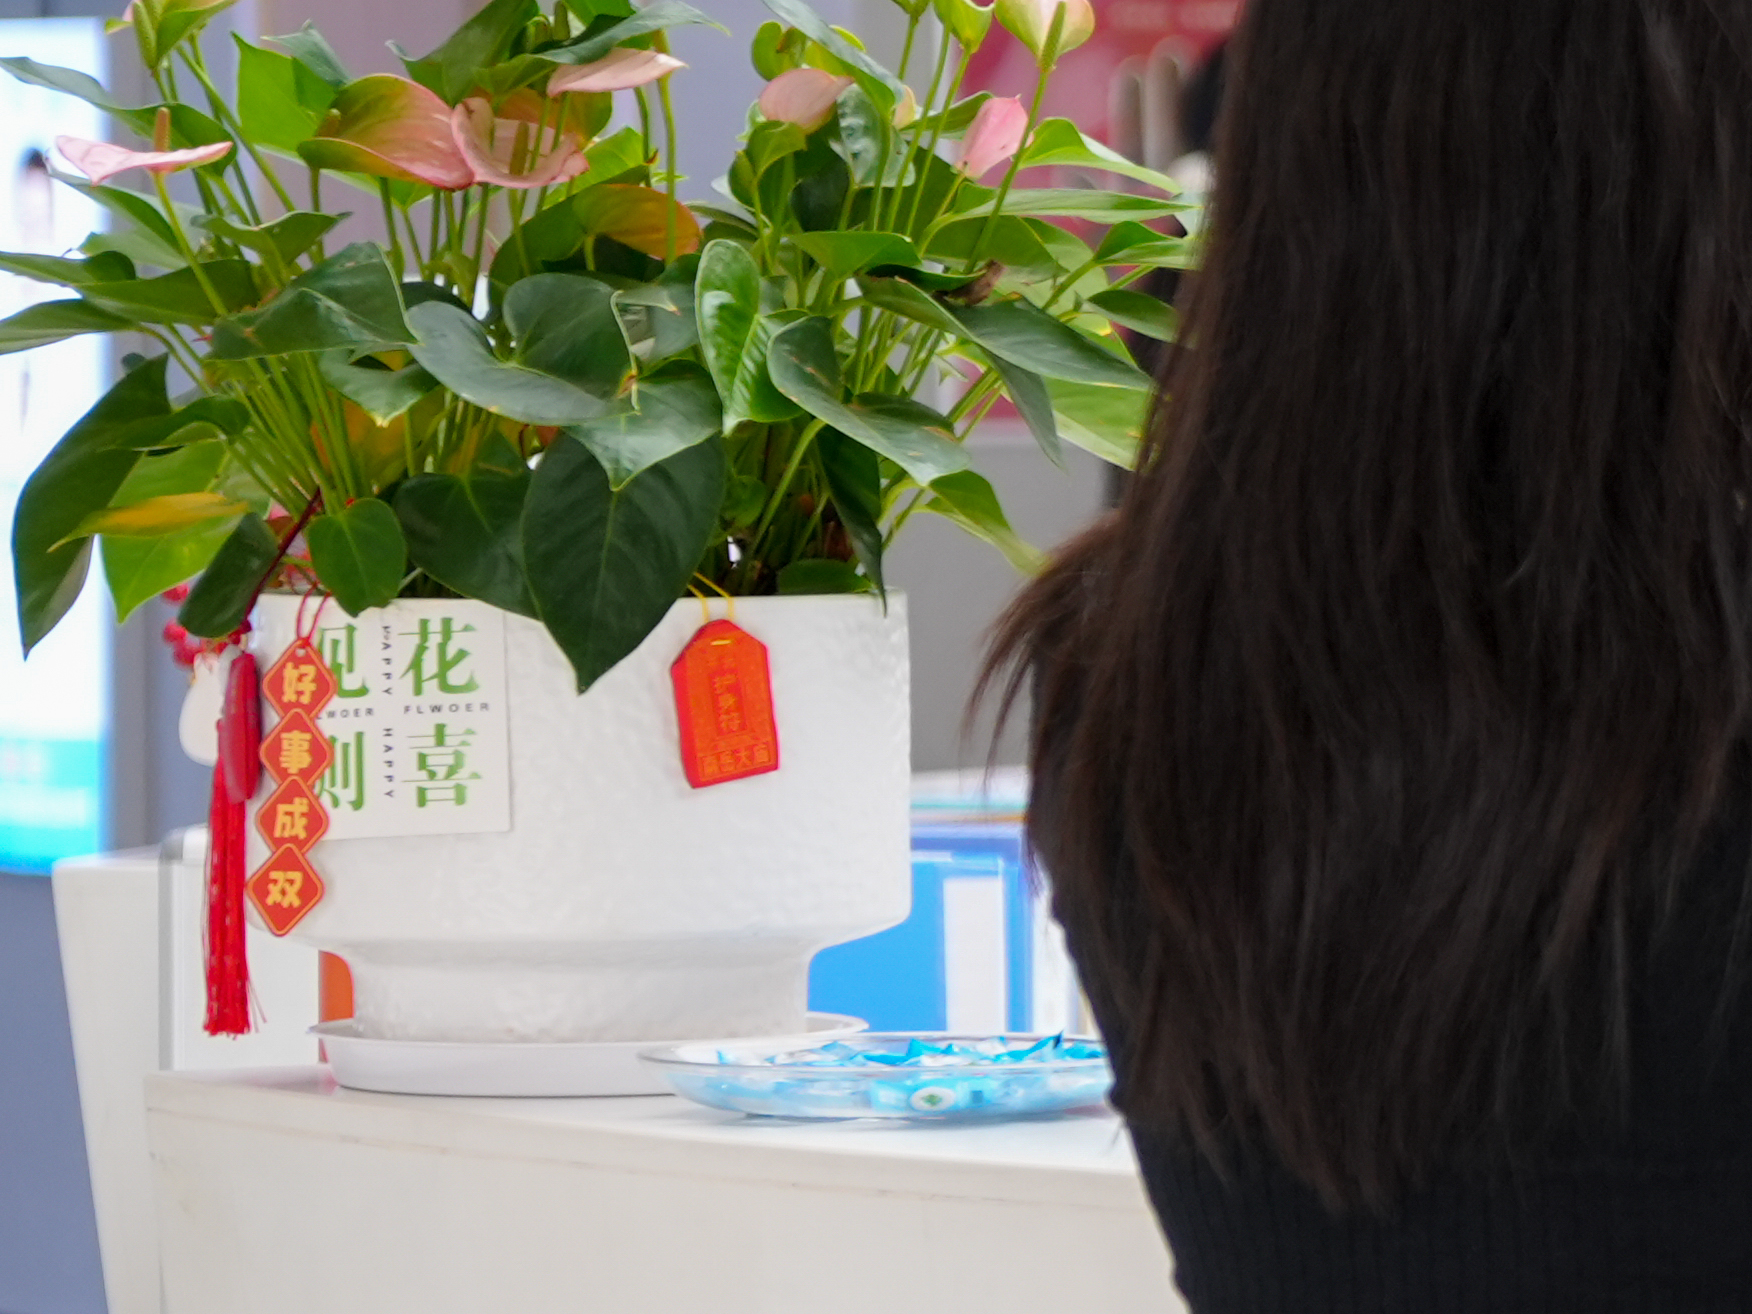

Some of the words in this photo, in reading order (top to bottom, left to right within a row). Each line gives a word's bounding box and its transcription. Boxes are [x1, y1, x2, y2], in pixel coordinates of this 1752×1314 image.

[403, 702, 490, 715] FLWOER
[266, 663, 317, 907] 好事成双
[383, 728, 394, 798] HAPPY
